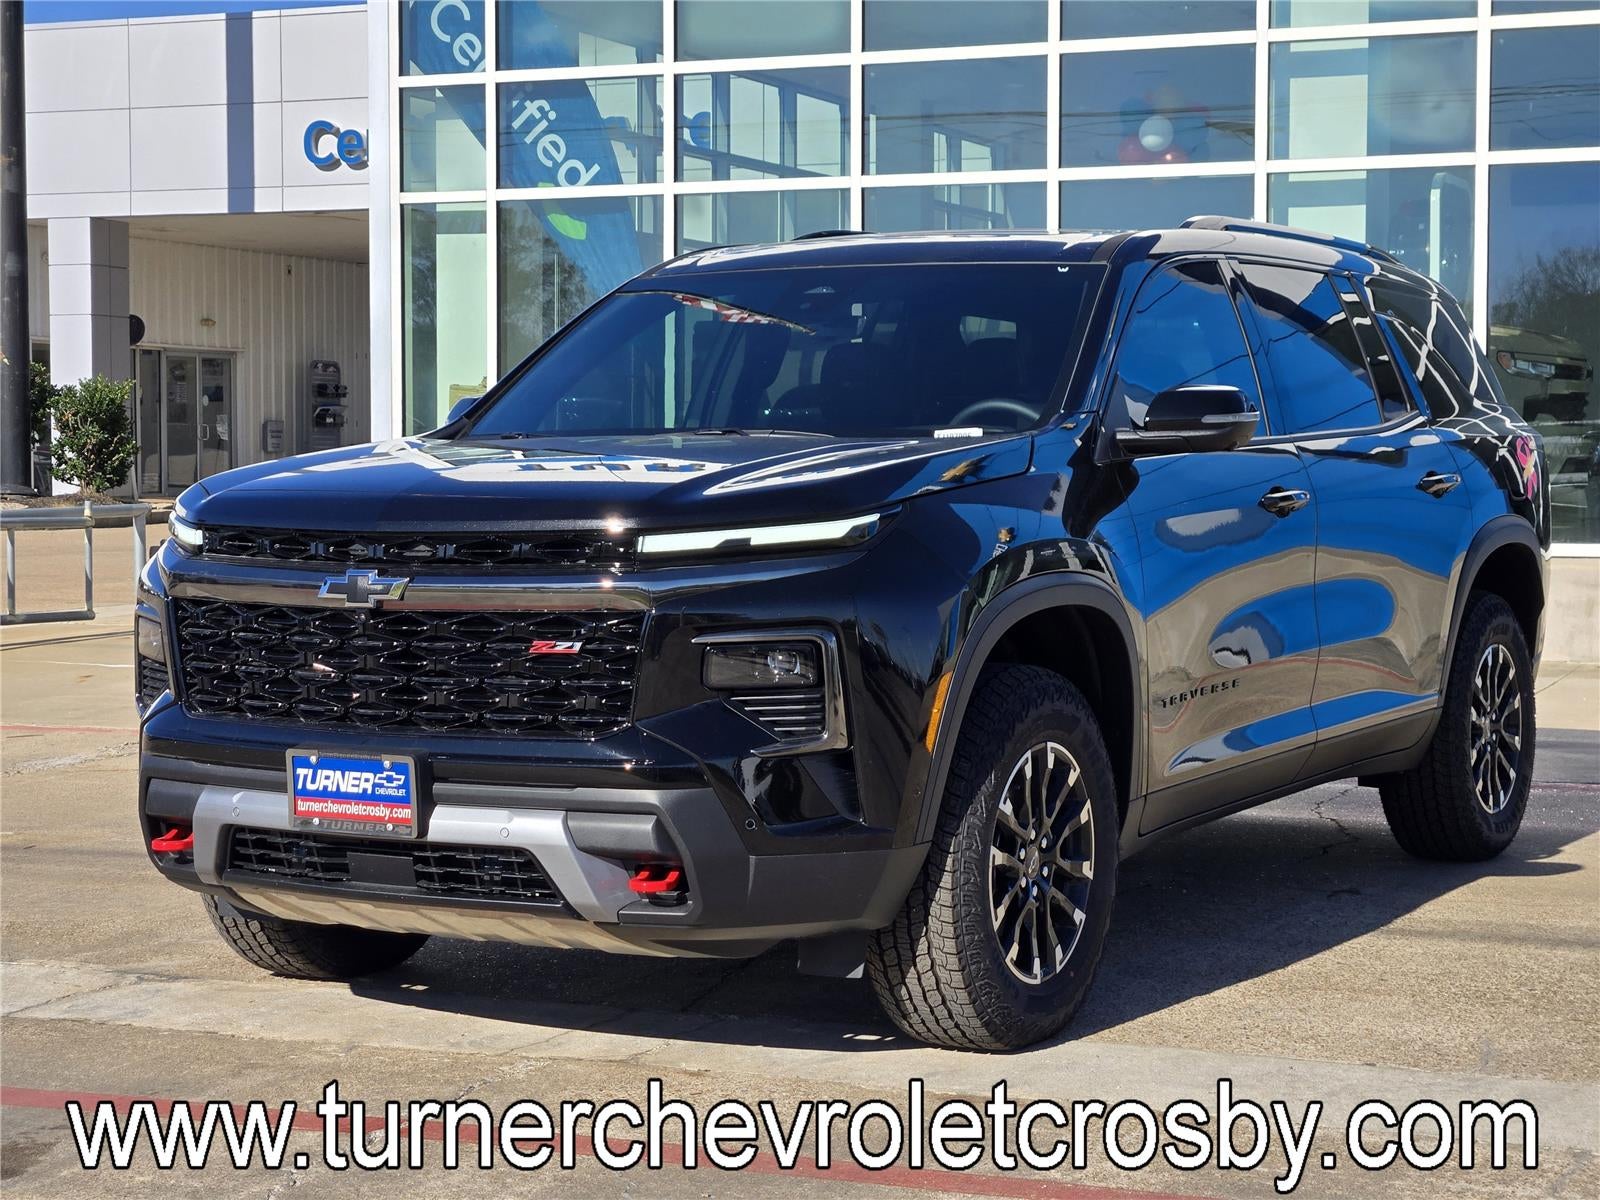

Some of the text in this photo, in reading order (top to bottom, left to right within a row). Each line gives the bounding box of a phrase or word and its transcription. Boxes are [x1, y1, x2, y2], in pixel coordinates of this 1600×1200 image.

[1161, 678, 1240, 708] TRAVERSE
[296, 767, 374, 794] TURNER
[375, 787, 406, 797] CHEVROLET
[297, 799, 412, 819] turnerchevroletcrosby.com
[322, 820, 386, 832] TURNER
